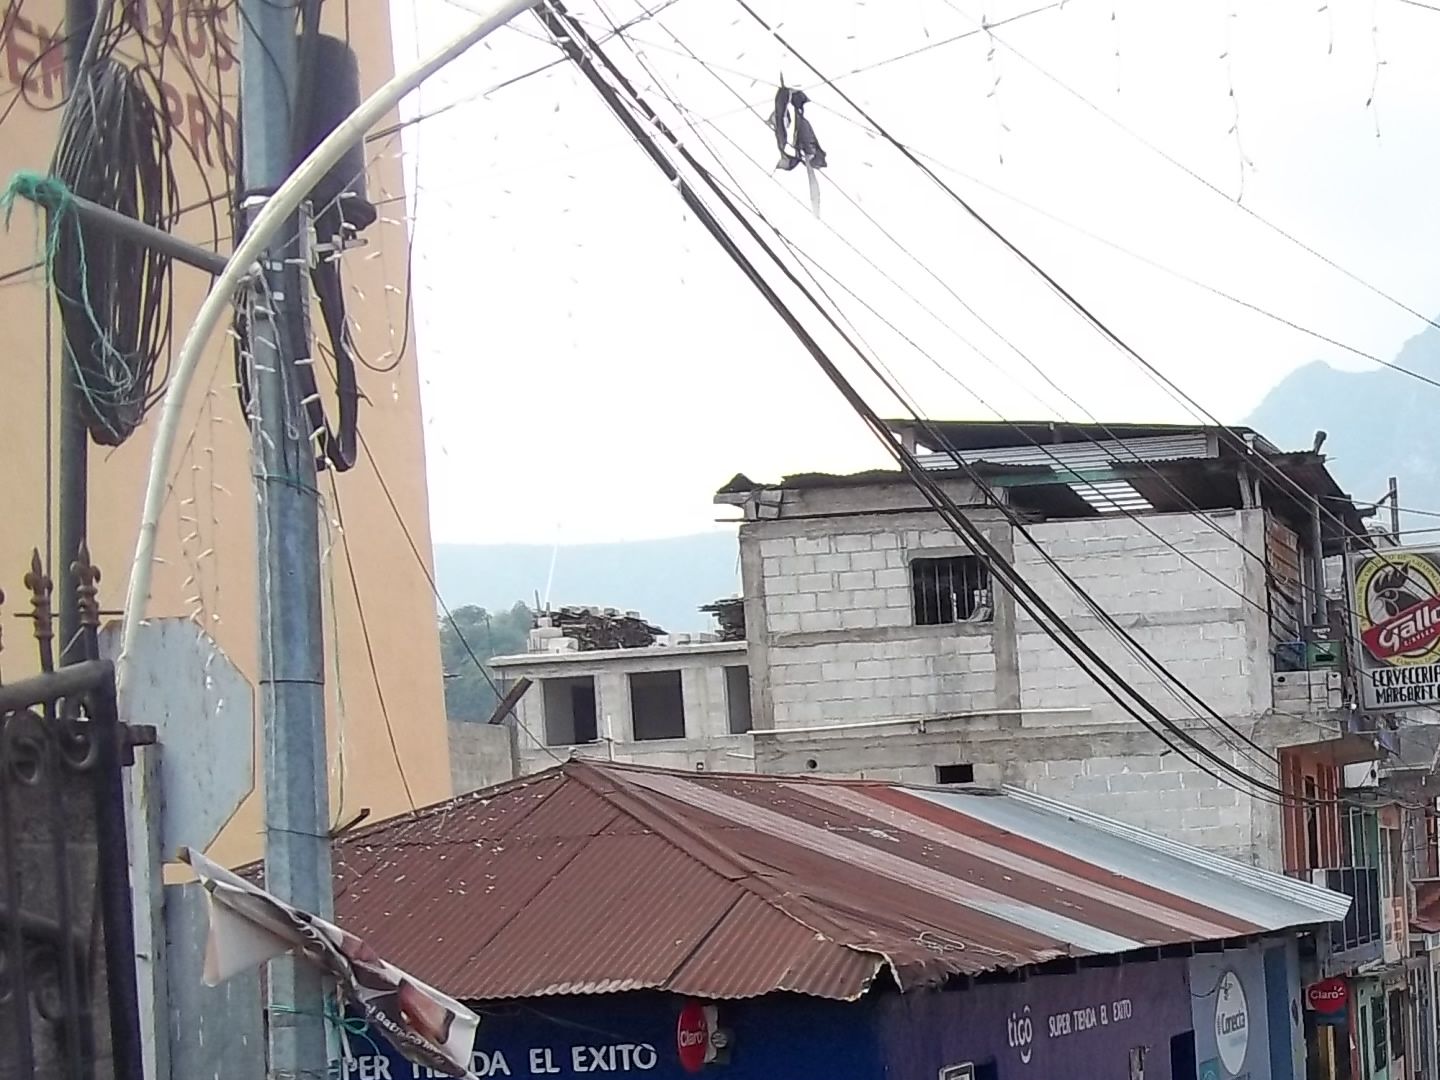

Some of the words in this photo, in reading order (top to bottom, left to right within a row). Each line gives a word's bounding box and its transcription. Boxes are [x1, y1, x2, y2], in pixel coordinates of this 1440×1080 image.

[1310, 988, 1338, 1000] Claro
[1048, 1012, 1071, 1038] SUPER
[1072, 1007, 1097, 1032] TIENDA
[1099, 1004, 1109, 1025] EL
[1113, 999, 1132, 1022] EXITO
[680, 1030, 703, 1047] Claro
[342, 1054, 392, 1080] PER
[529, 1048, 560, 1074] EL
[571, 1043, 659, 1071] EXITO
